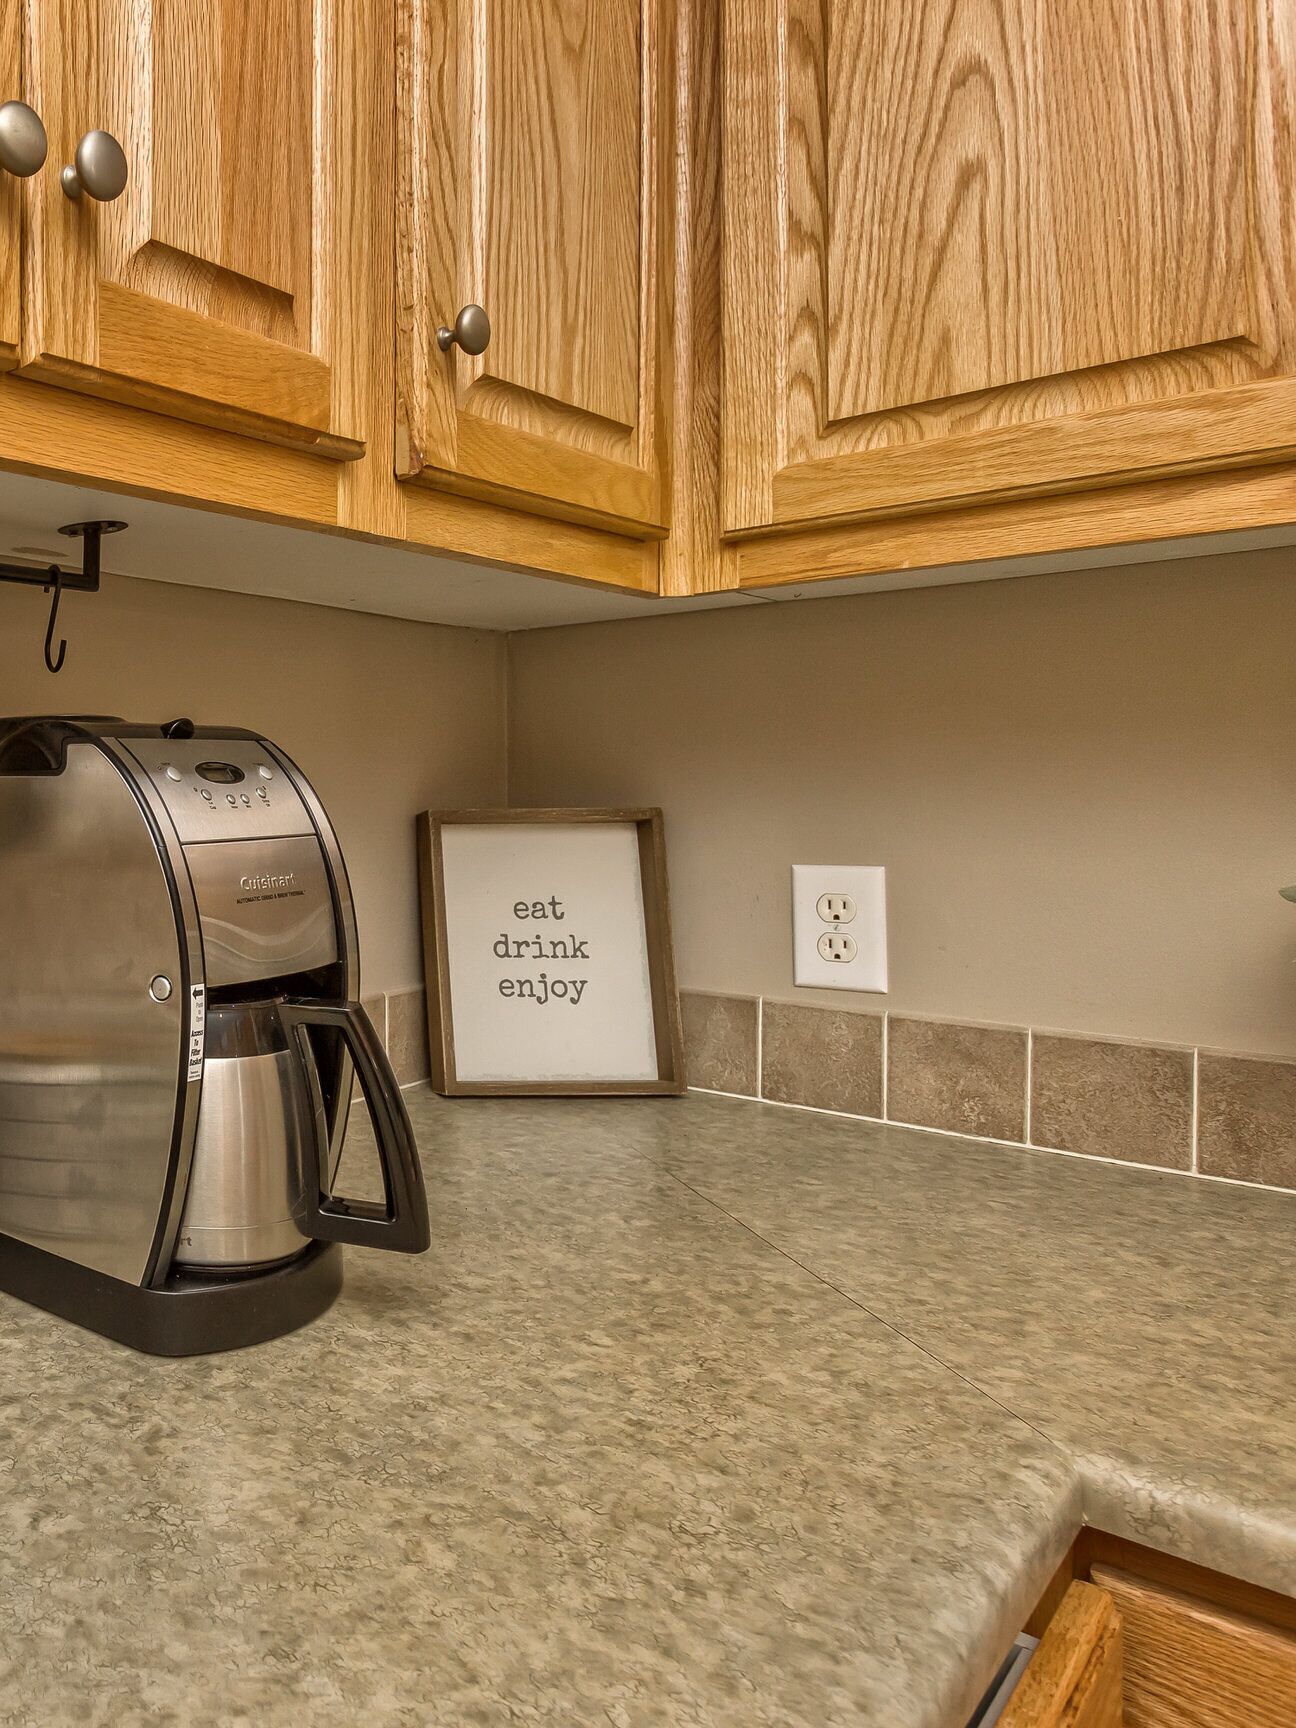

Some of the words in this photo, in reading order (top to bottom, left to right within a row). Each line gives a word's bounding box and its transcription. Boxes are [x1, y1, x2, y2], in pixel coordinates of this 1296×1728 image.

[240, 873, 296, 890] Cuisinart
[513, 895, 565, 920] eat
[493, 933, 590, 959] drink
[498, 973, 588, 1005] enjoy
